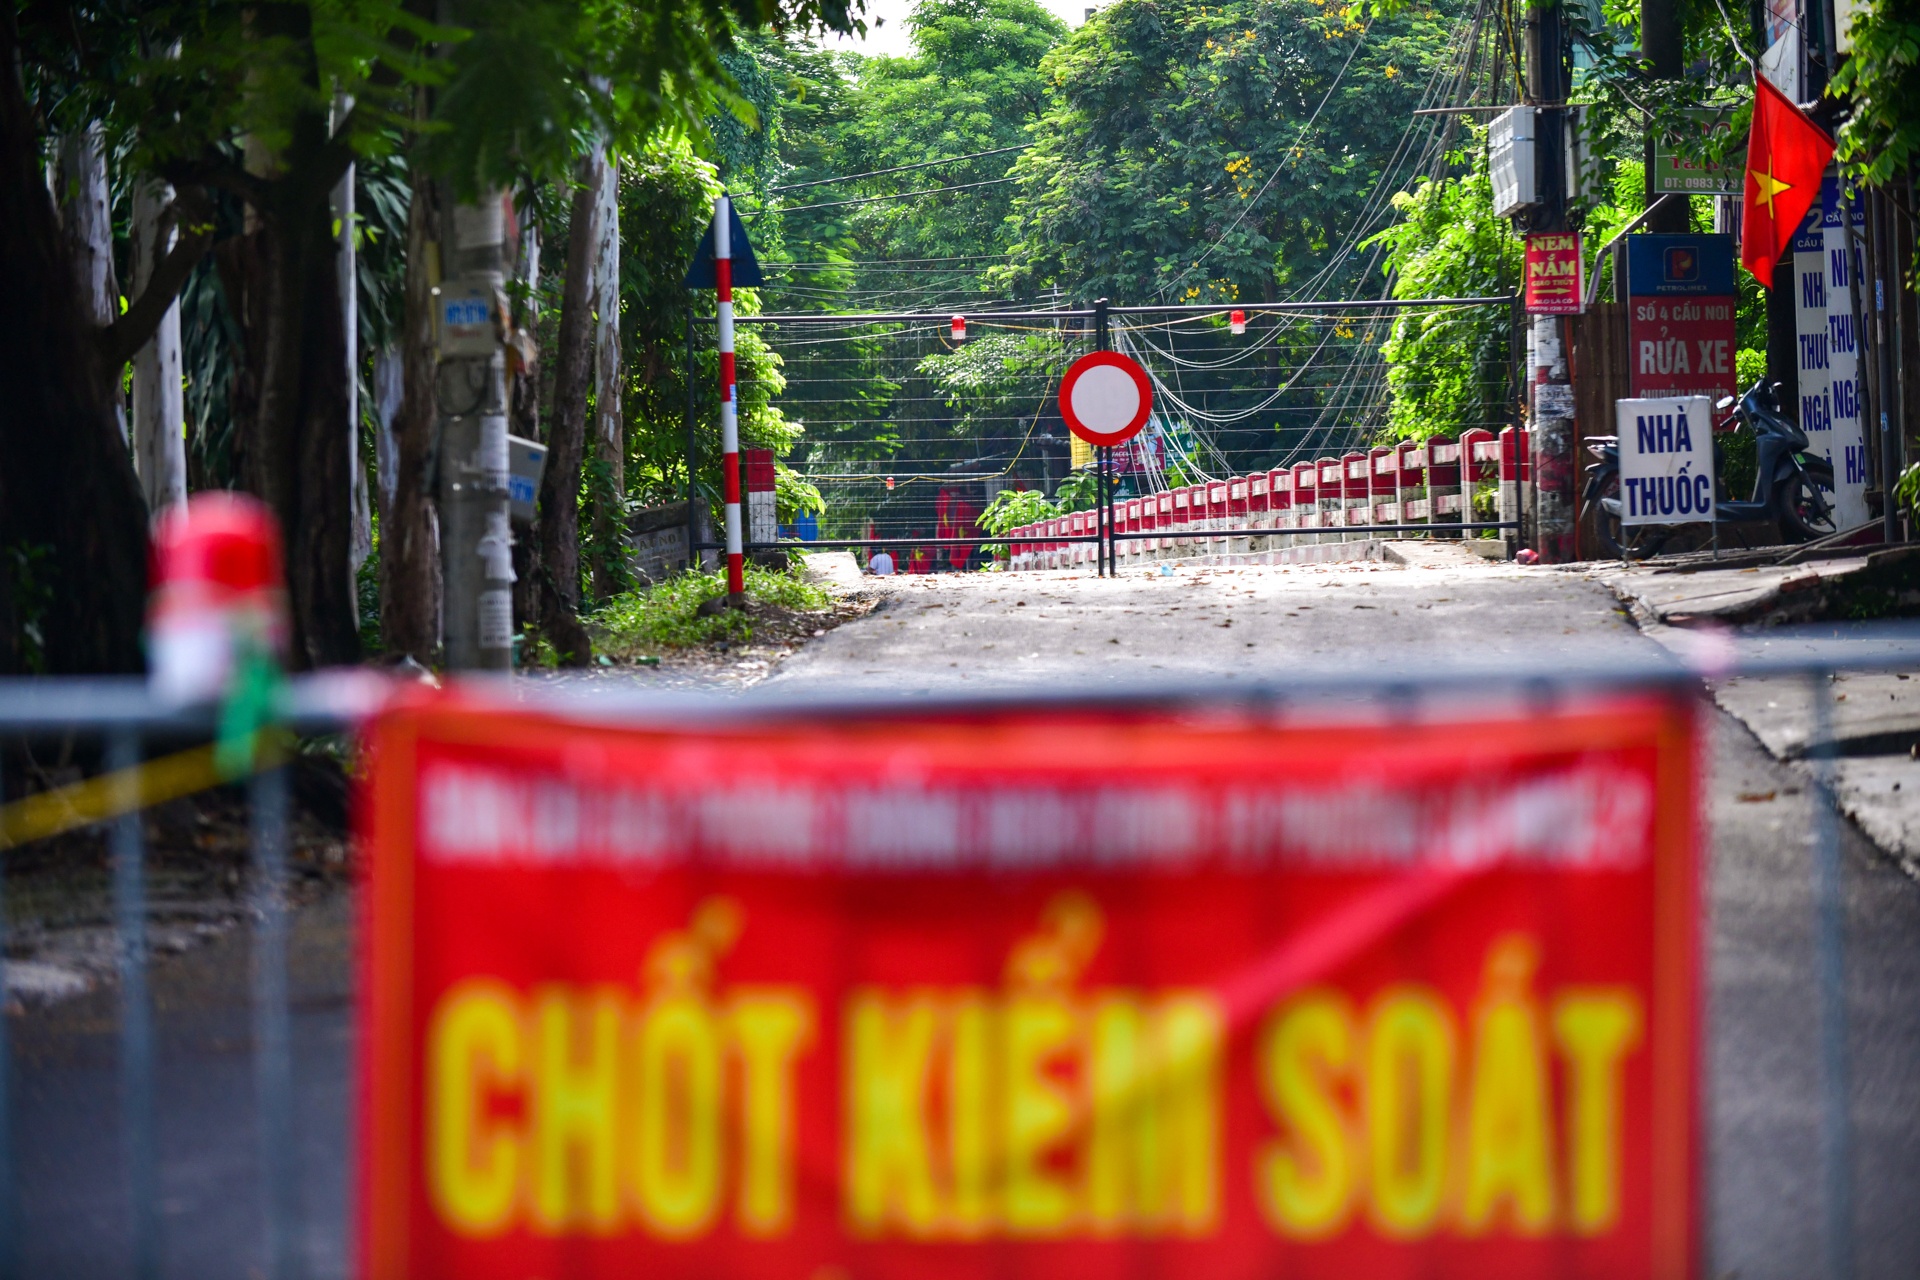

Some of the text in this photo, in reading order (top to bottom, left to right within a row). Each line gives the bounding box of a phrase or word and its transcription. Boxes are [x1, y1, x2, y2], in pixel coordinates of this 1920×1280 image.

[1685, 178, 1713, 189] 0983
[1530, 236, 1574, 252] NEM
[1529, 253, 1576, 278] NẮM
[1802, 271, 1827, 309] NH
[1637, 300, 1657, 321] SỐ
[1660, 306, 1668, 321] 4
[1640, 326, 1729, 374] RỬA XE
[1637, 405, 1693, 454] NHÀ
[1625, 460, 1710, 516] THUỐC
[432, 892, 1643, 1240] CHỐT KIỂM SOÁT
